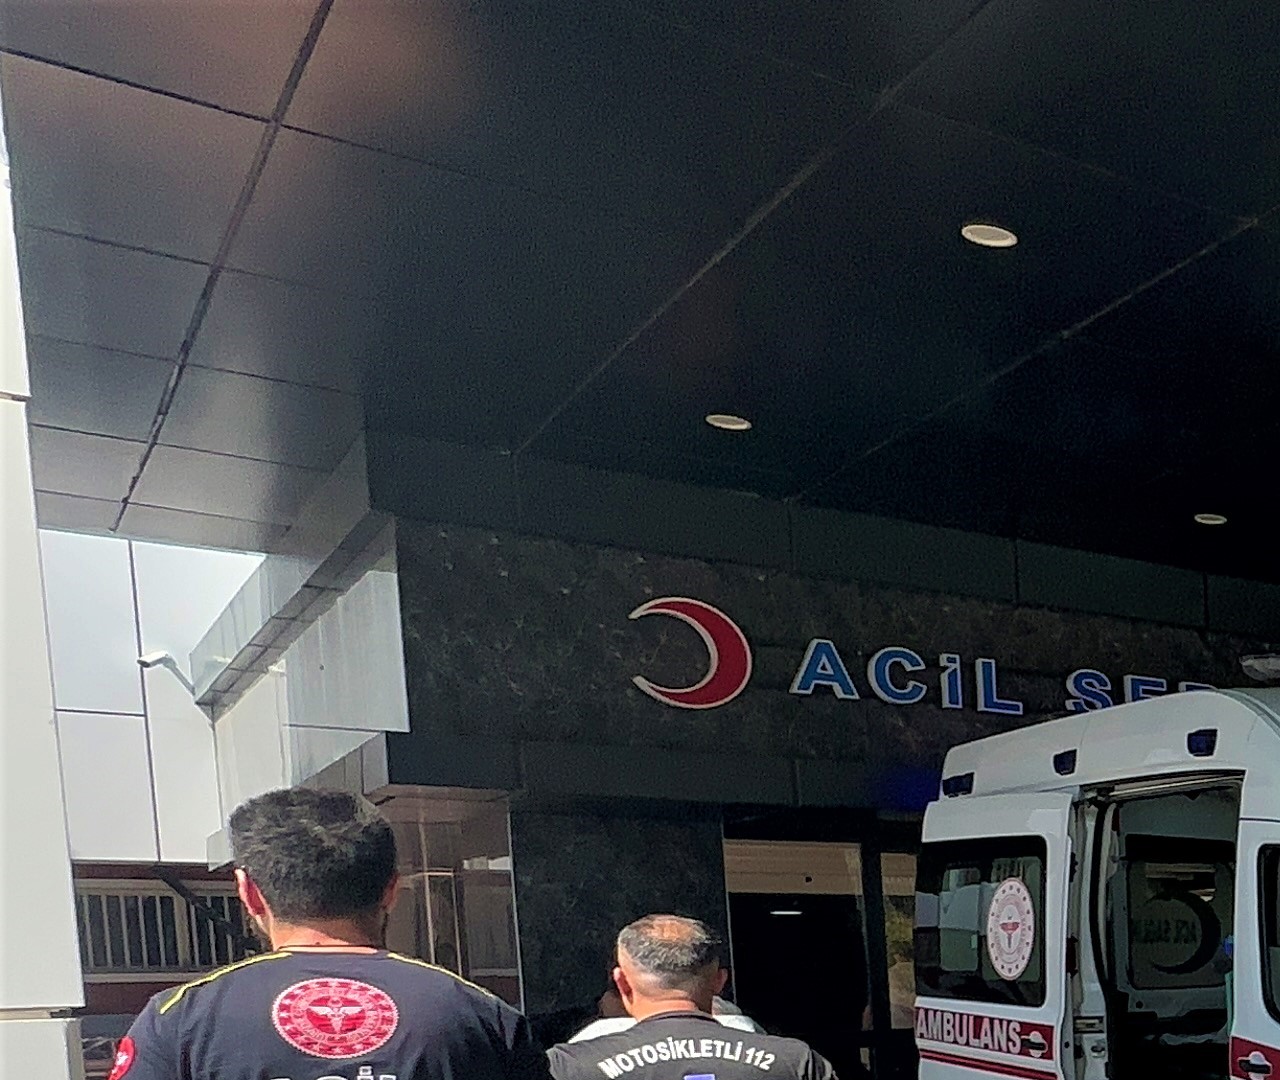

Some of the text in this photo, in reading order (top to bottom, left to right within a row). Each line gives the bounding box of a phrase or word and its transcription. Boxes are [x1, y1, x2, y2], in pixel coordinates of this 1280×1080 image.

[789, 638, 1024, 715] ACİL
[916, 1008, 1022, 1055] AMBULANS
[597, 1036, 776, 1080] MOTOSİKLETLİ 112
